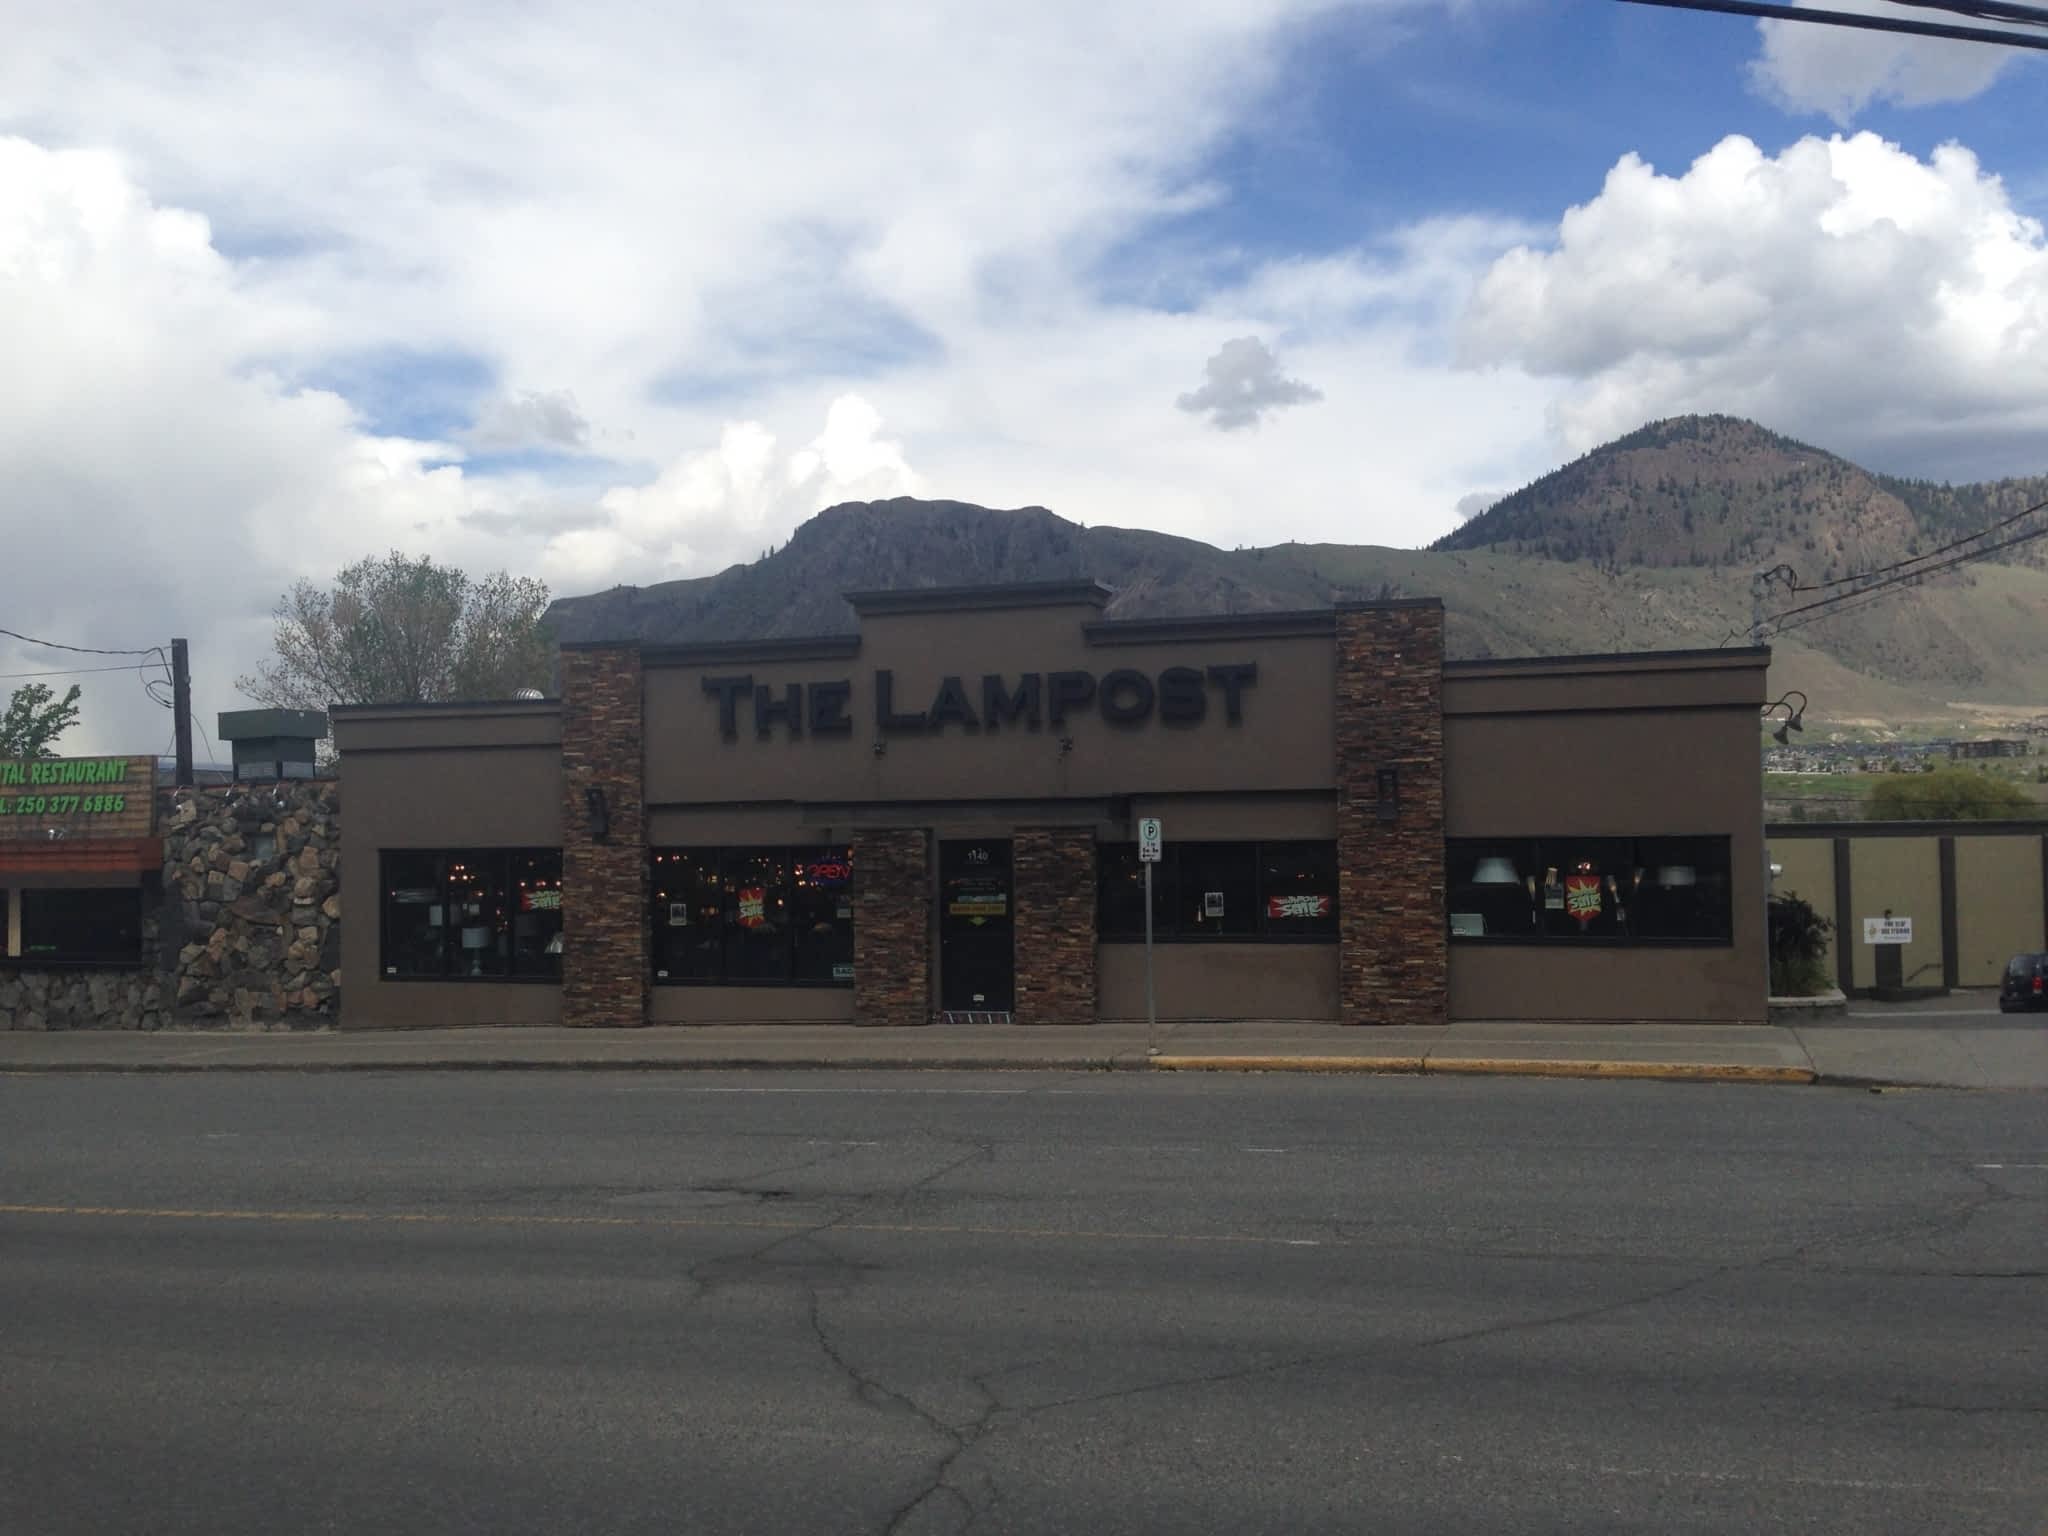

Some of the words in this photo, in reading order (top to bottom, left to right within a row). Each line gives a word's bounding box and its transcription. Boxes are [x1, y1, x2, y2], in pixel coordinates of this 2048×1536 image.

[875, 662, 1258, 736] LAMPOST
[31, 759, 128, 785] RESTAURANT
[16, 796, 45, 814] 250
[49, 795, 80, 814] 377
[83, 794, 125, 814] 6886
